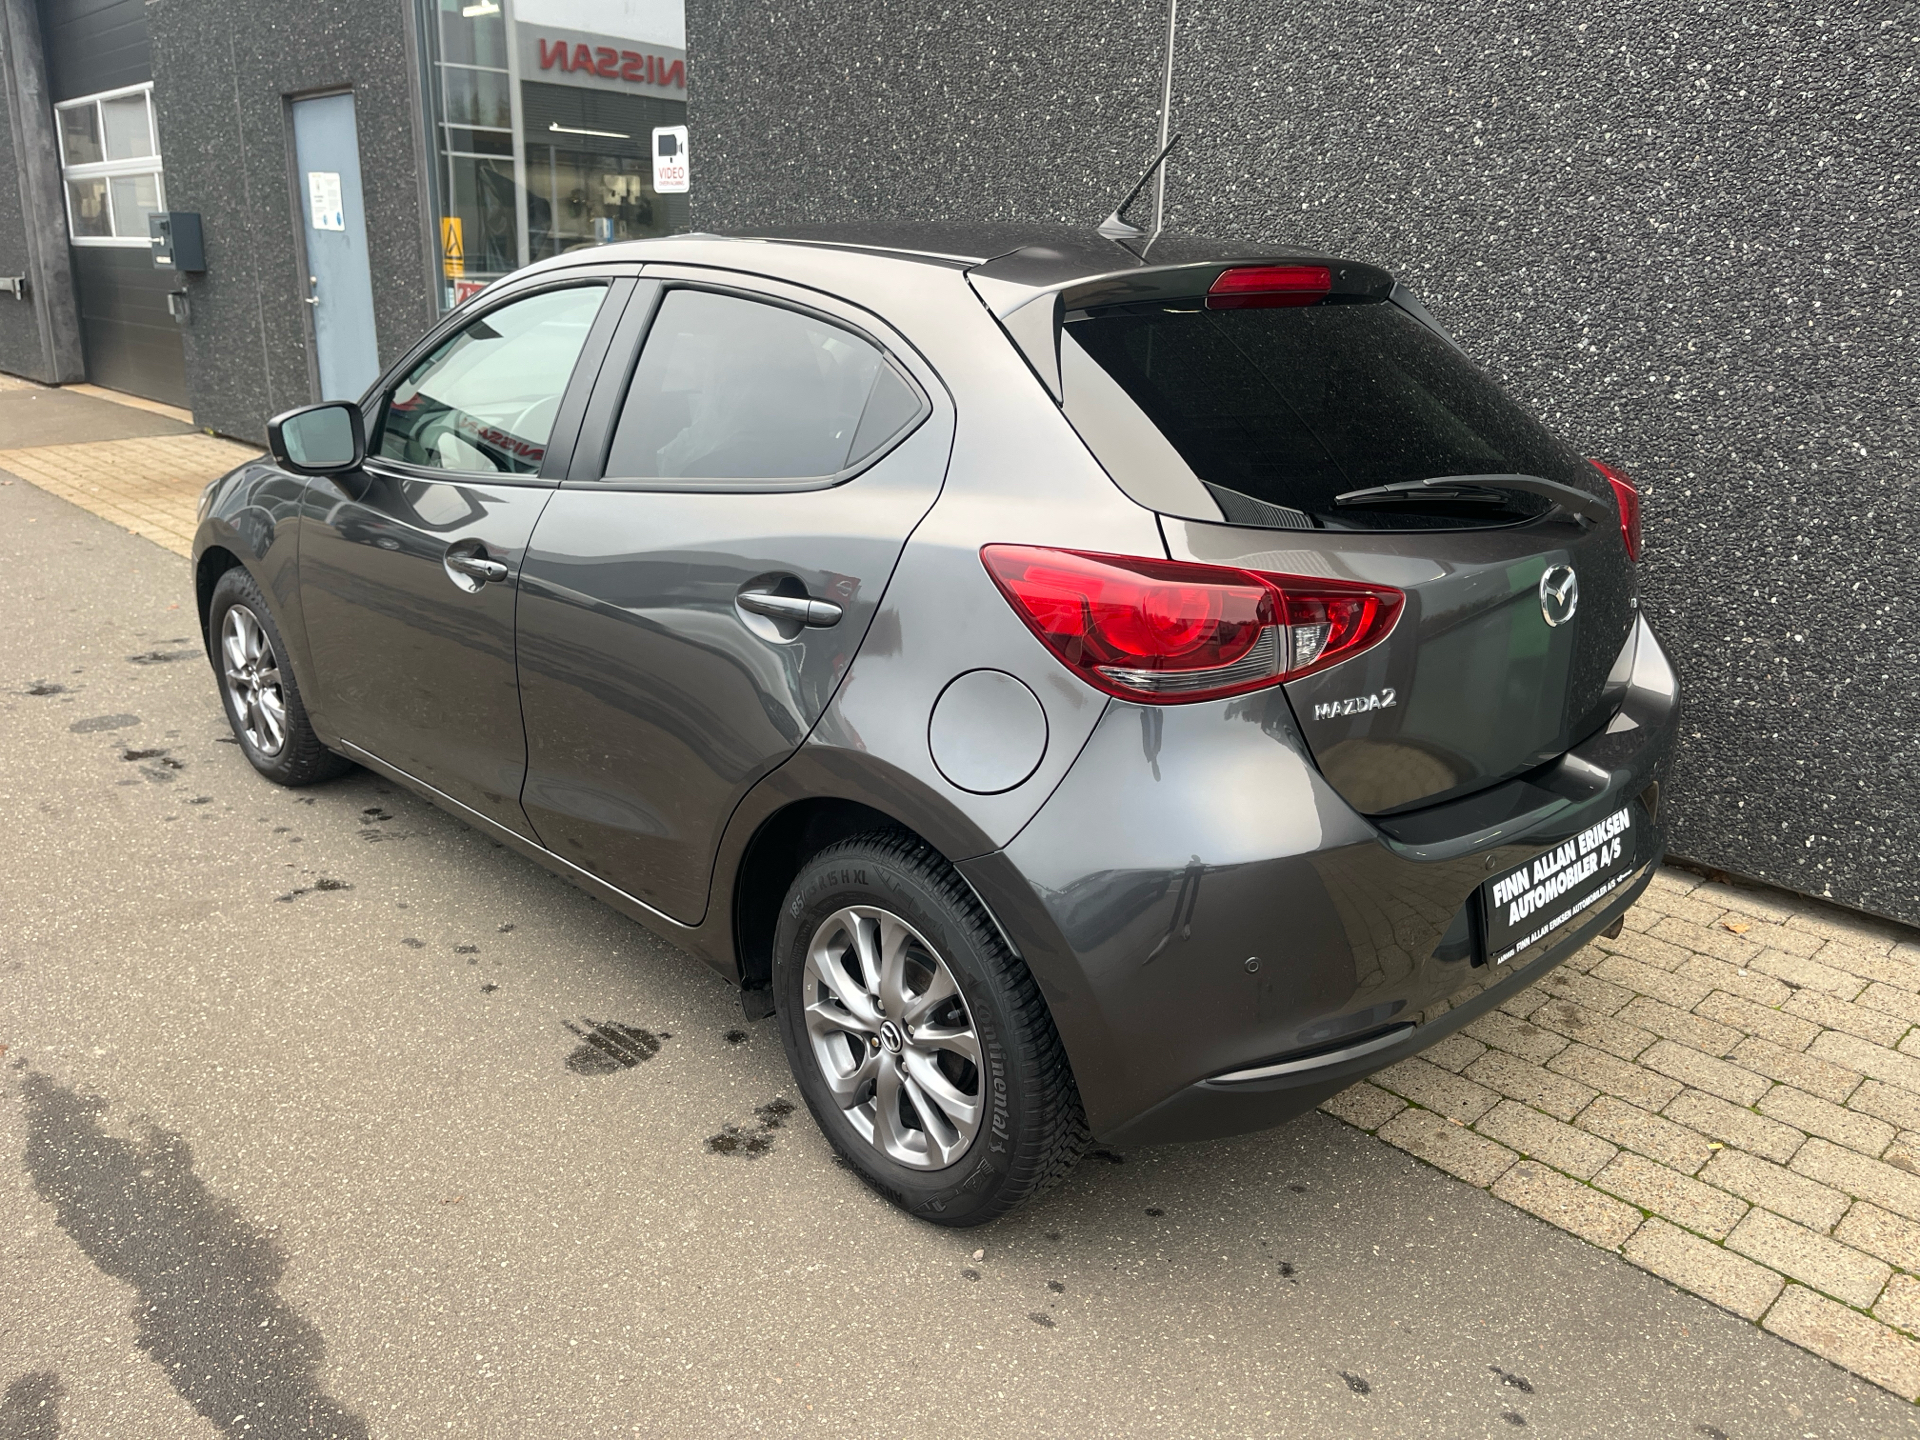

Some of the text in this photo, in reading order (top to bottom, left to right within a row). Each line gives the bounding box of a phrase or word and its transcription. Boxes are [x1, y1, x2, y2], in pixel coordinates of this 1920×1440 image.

[658, 166, 685, 180] VIDEO
[1313, 687, 1397, 720] MAZDA2
[1492, 807, 1631, 908] FINN ALLAN ERIKSEN
[1508, 837, 1621, 926] AUTOMOBILER A/S
[1515, 939, 1532, 952] FINN
[1531, 924, 1549, 943] ALLAN
[1549, 908, 1572, 931] ERIKSEN
[1572, 885, 1607, 915] AUTOMOBILER
